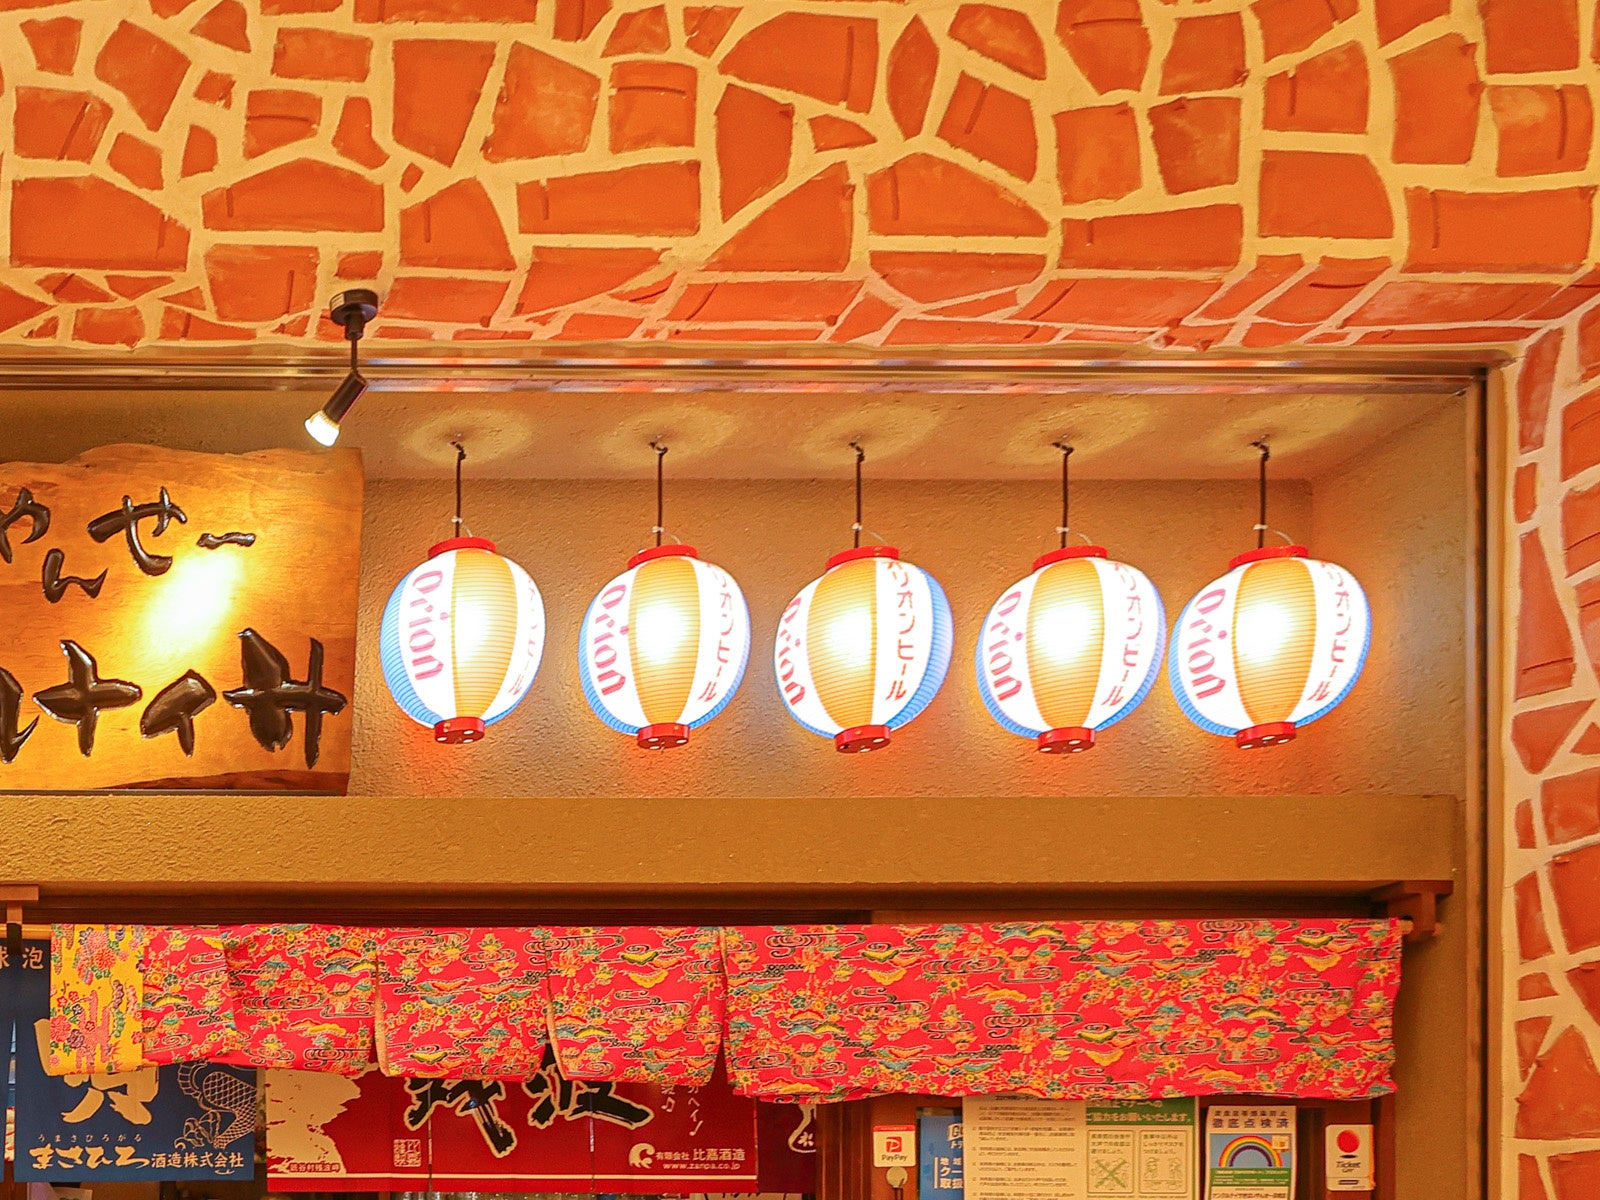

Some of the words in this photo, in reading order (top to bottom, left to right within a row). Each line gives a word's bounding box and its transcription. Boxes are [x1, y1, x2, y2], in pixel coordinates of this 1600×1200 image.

[38, 1134, 143, 1143] うまさひろがる
[29, 1143, 151, 1170] まさひろ
[151, 1152, 245, 1168] 酒造株式会社
[692, 1148, 746, 1161] 比嘉酒造
[881, 1154, 908, 1162] PayPay
[662, 1162, 741, 1171] www.zanpa.co.jp
